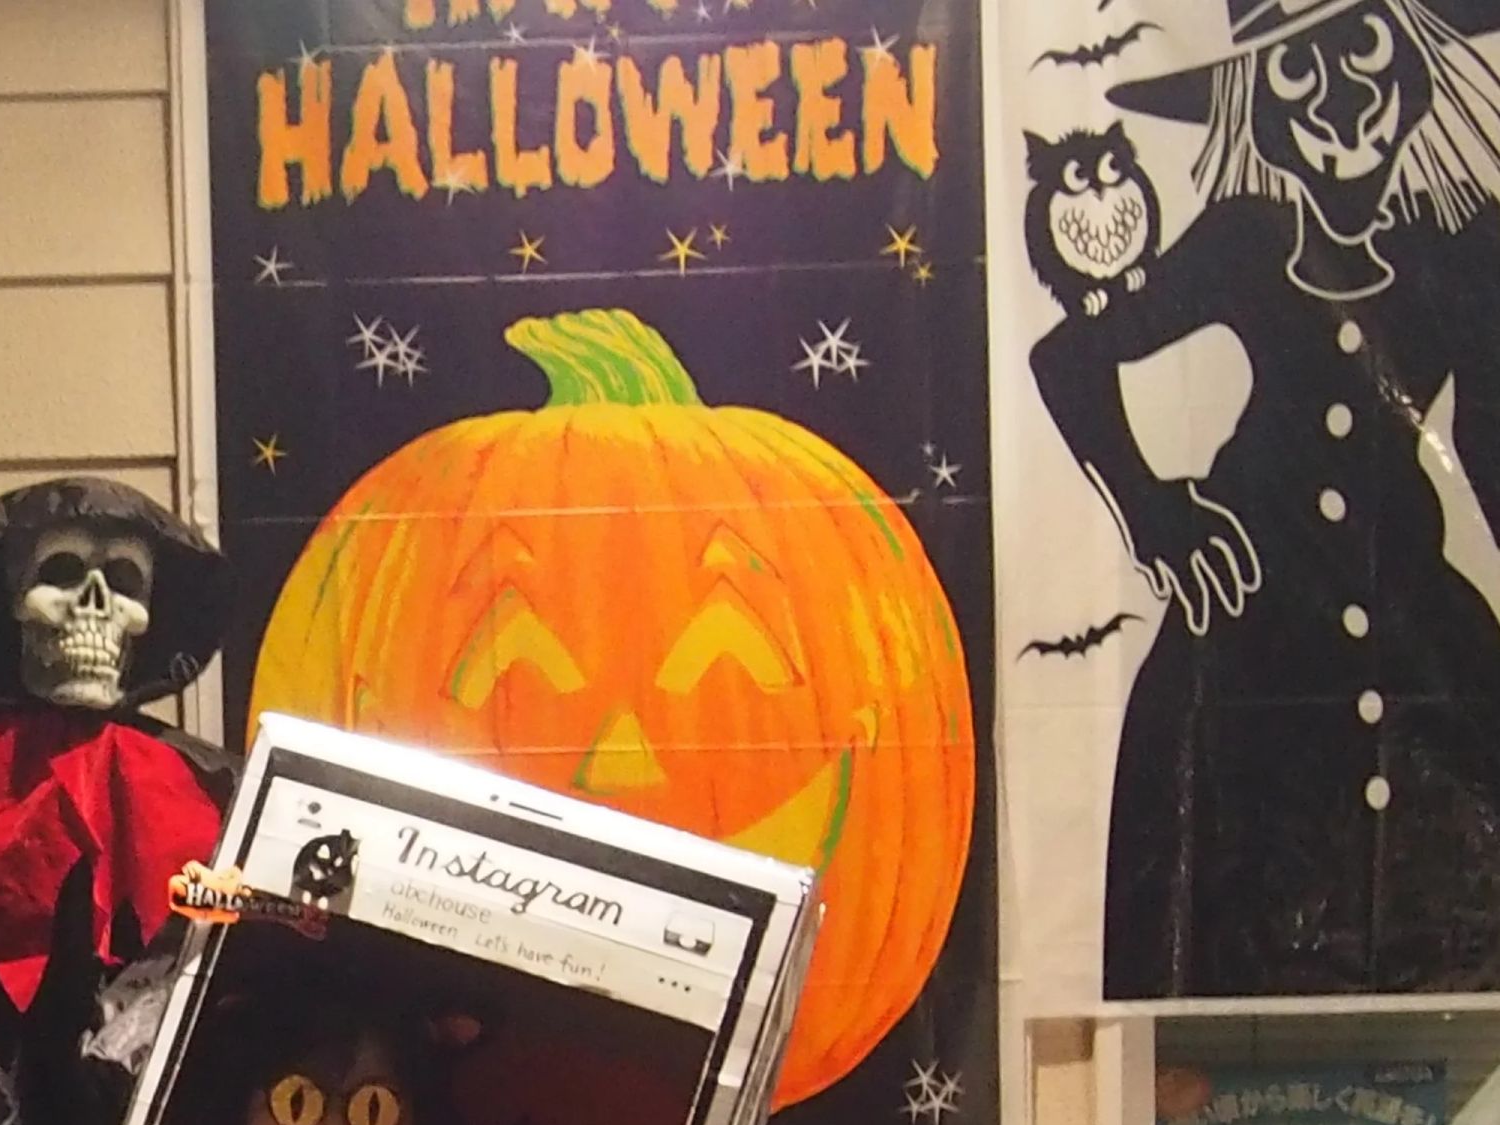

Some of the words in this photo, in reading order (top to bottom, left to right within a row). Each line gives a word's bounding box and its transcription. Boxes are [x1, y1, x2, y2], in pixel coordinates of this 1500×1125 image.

[256, 36, 940, 209] HALLOWEEN
[391, 879, 493, 925] abchouse
[398, 826, 623, 926] Instagram
[382, 902, 458, 939] Halloween
[517, 945, 553, 964] have
